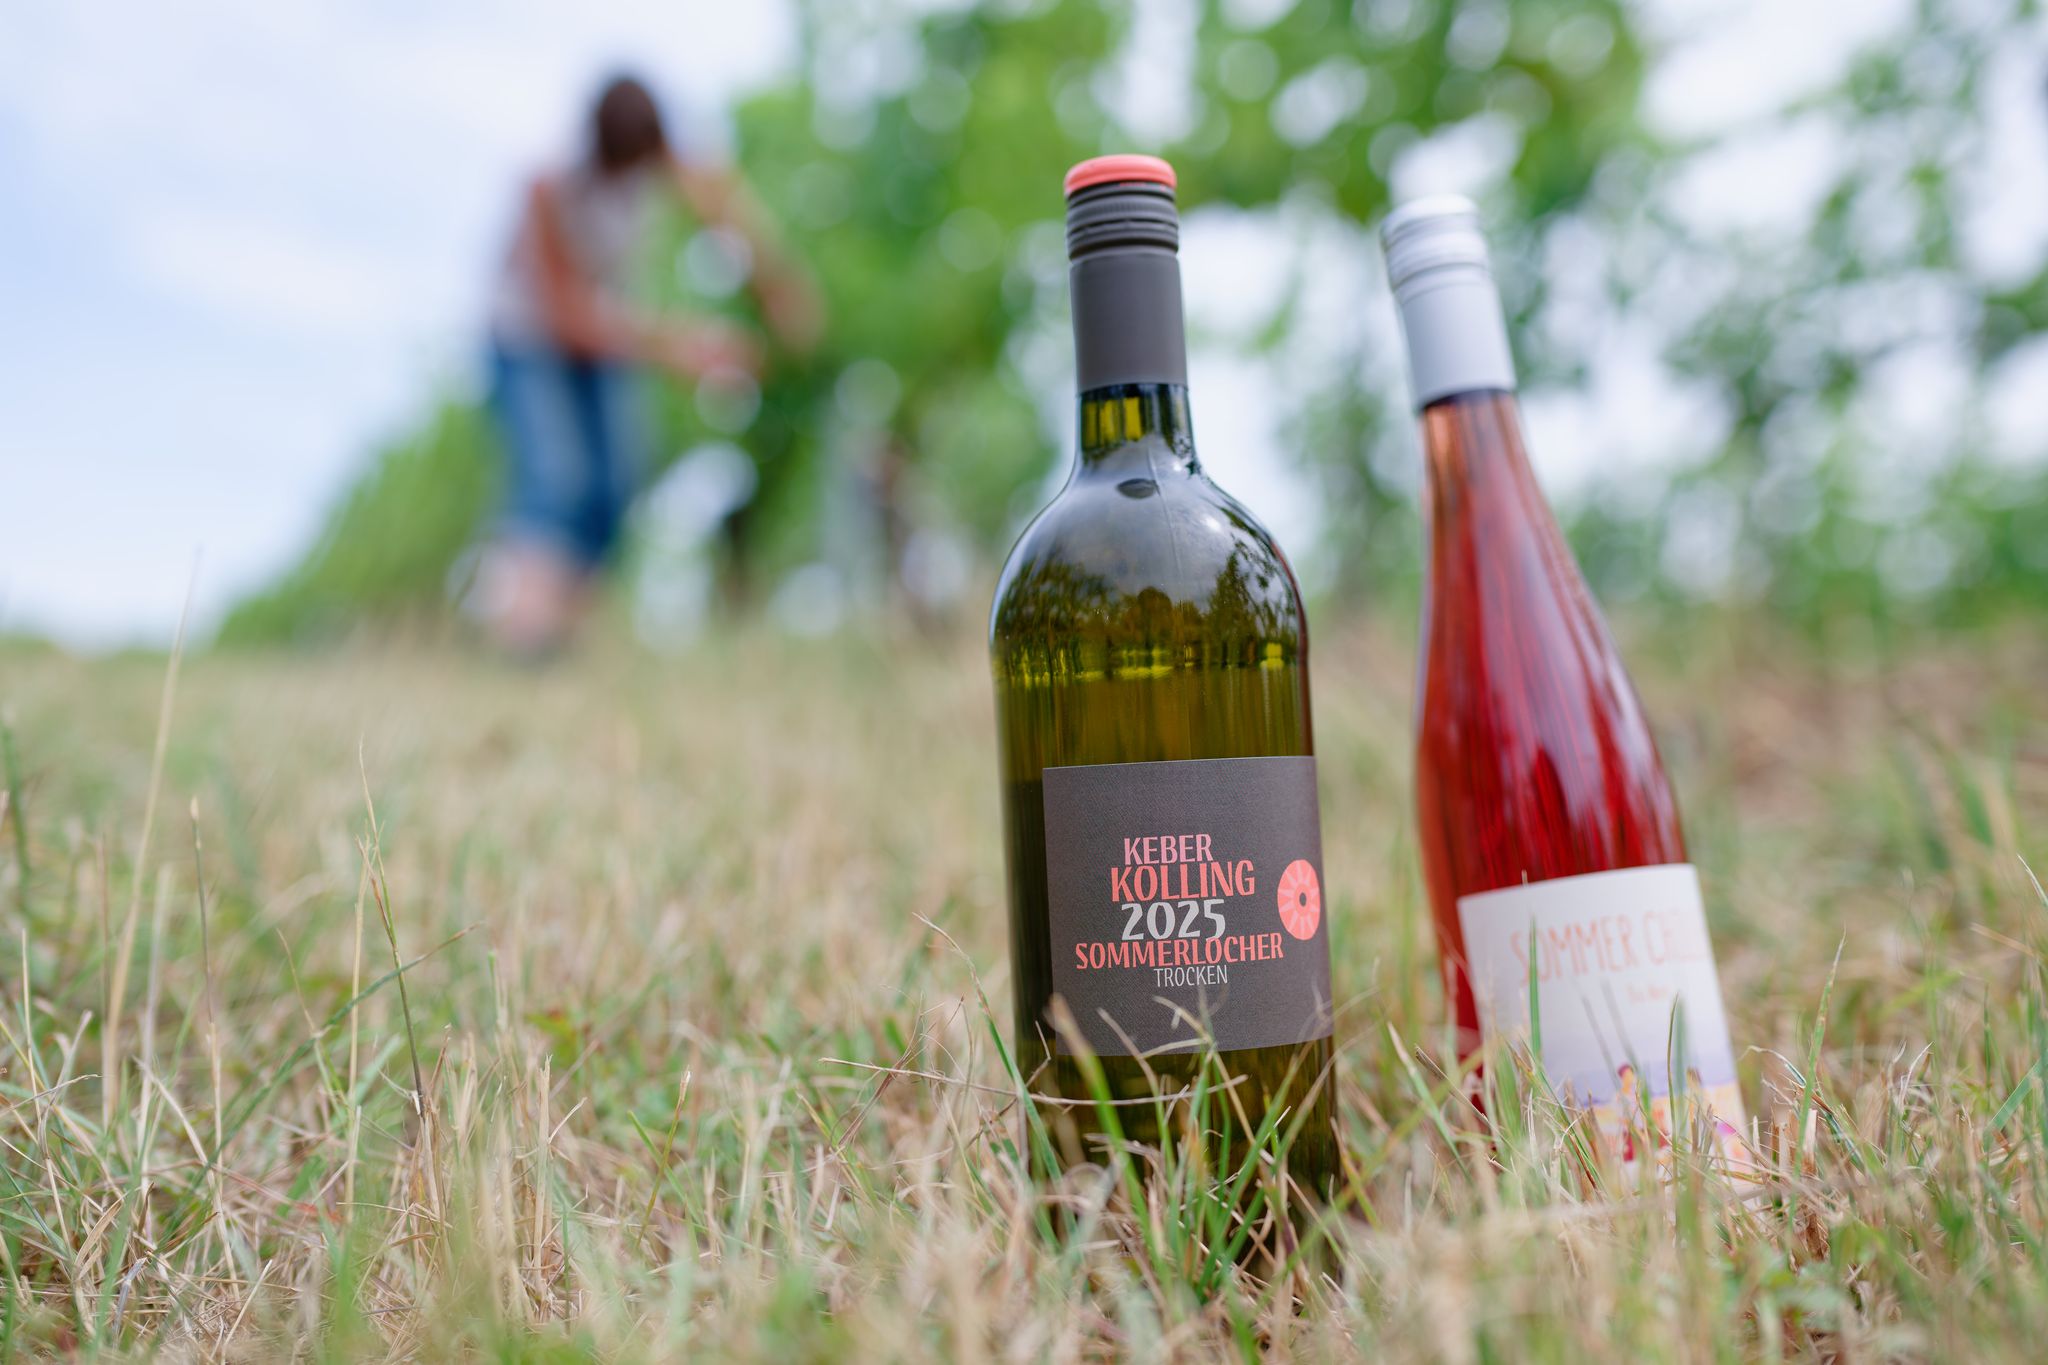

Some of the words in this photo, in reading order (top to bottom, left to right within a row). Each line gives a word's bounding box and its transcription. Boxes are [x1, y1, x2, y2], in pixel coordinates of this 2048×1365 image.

[1124, 834, 1213, 865] KEBER
[1111, 860, 1255, 902] KOLLING
[1121, 899, 1226, 941] 2025
[1075, 932, 1284, 970] SOMMERLOCHER
[1153, 965, 1228, 987] TROCKEN
